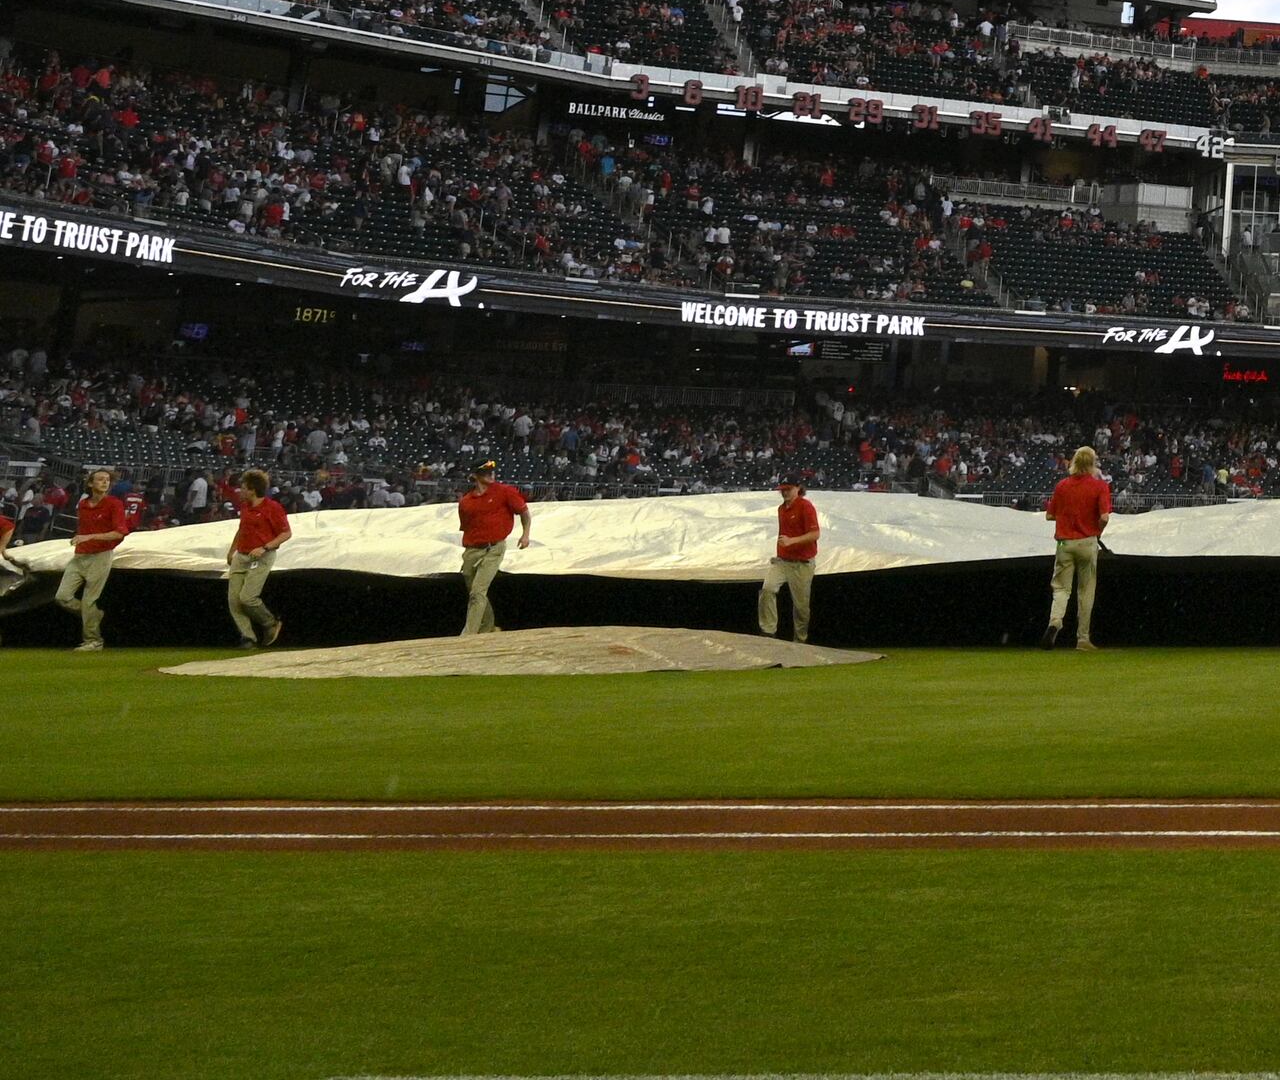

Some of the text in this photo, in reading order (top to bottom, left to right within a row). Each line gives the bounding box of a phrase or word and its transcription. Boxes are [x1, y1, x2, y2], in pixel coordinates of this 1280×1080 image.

[631, 74, 649, 100] 3
[735, 85, 764, 111] 10
[569, 102, 665, 122] BALLPARK Classics
[793, 92, 822, 119] 21
[849, 97, 883, 124] 29
[912, 104, 939, 130] 31
[970, 110, 1002, 136] 35
[1028, 116, 1053, 142] 41
[1087, 123, 1118, 148] 44
[1140, 129, 1168, 153] 47
[1196, 135, 1225, 158] 42
[0, 210, 176, 263] E TO TRUIST PARK
[340, 268, 379, 288] FOR
[379, 271, 419, 289] THE
[294, 306, 327, 324] 1871
[681, 301, 926, 336] WELCOME TO TRUIST PARK
[1102, 326, 1134, 344] FOR
[1137, 327, 1169, 344] THE
